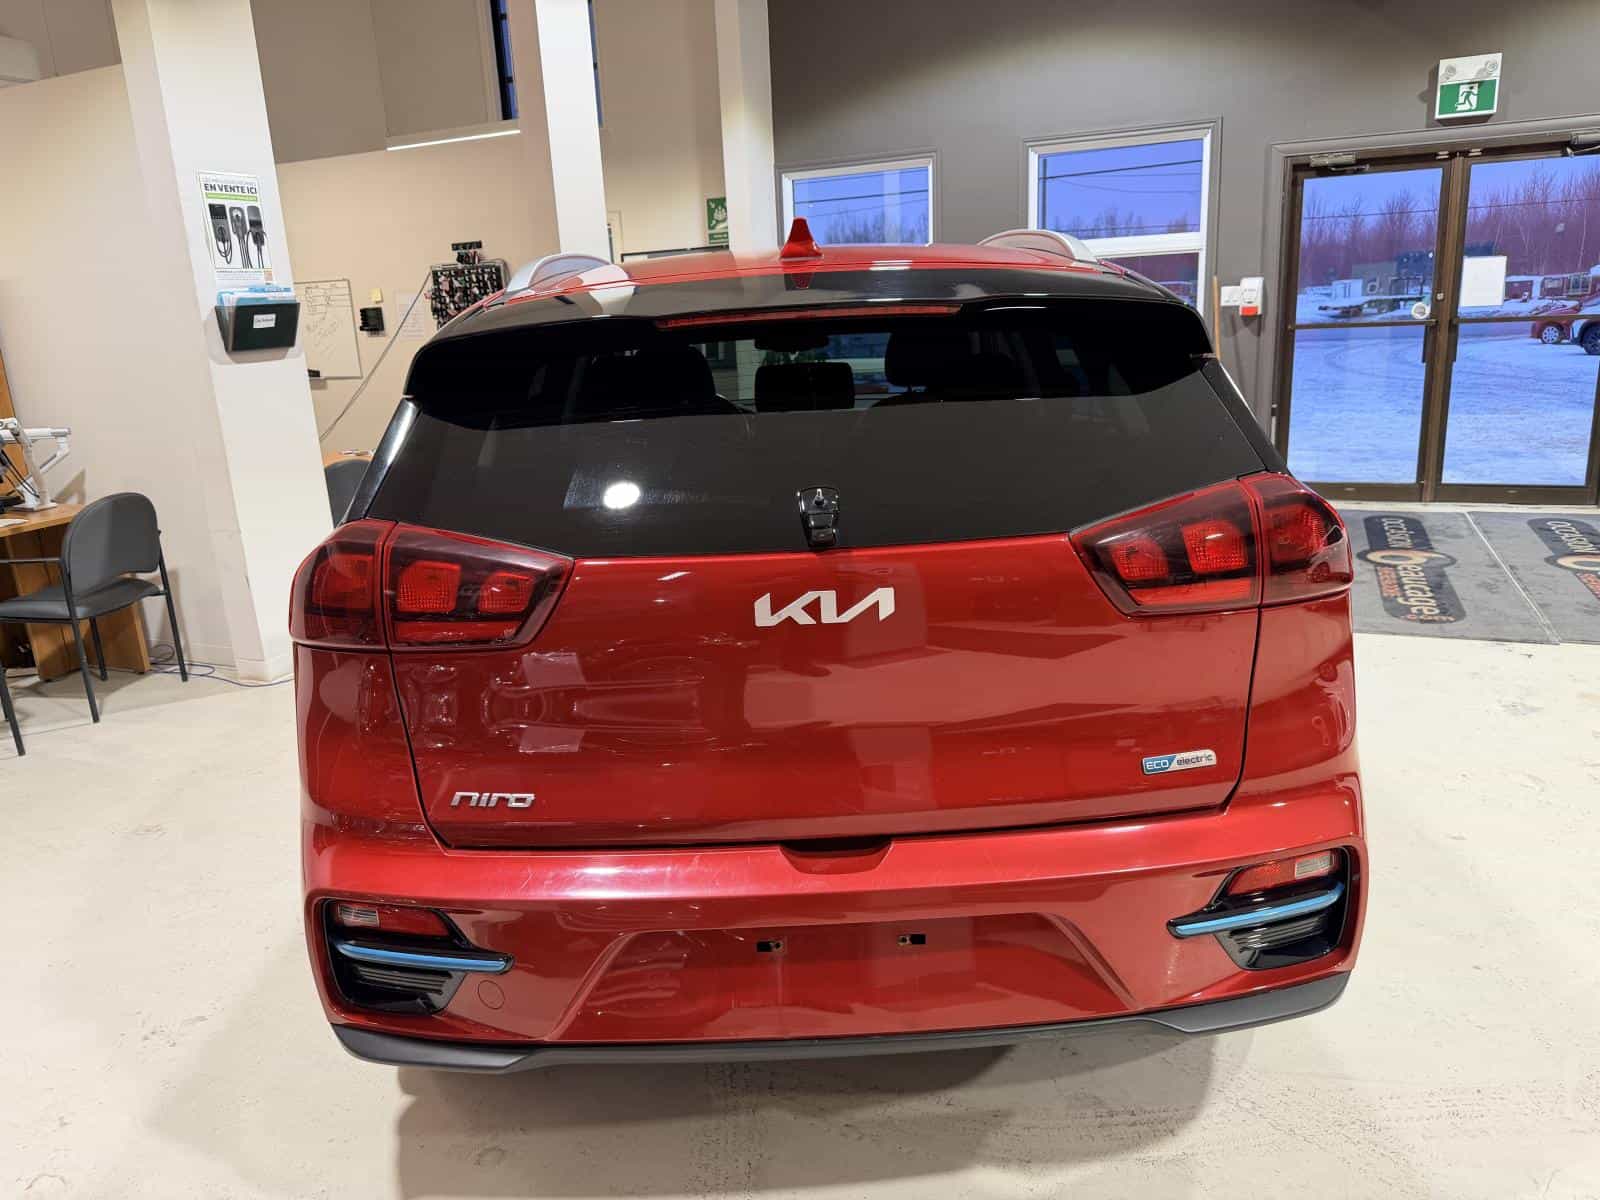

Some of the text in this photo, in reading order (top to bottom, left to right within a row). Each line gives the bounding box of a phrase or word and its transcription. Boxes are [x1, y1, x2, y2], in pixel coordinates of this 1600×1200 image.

[204, 183, 257, 195] EN VENTE ICI
[754, 587, 895, 627] KIA
[1146, 754, 1213, 770] ECO electric
